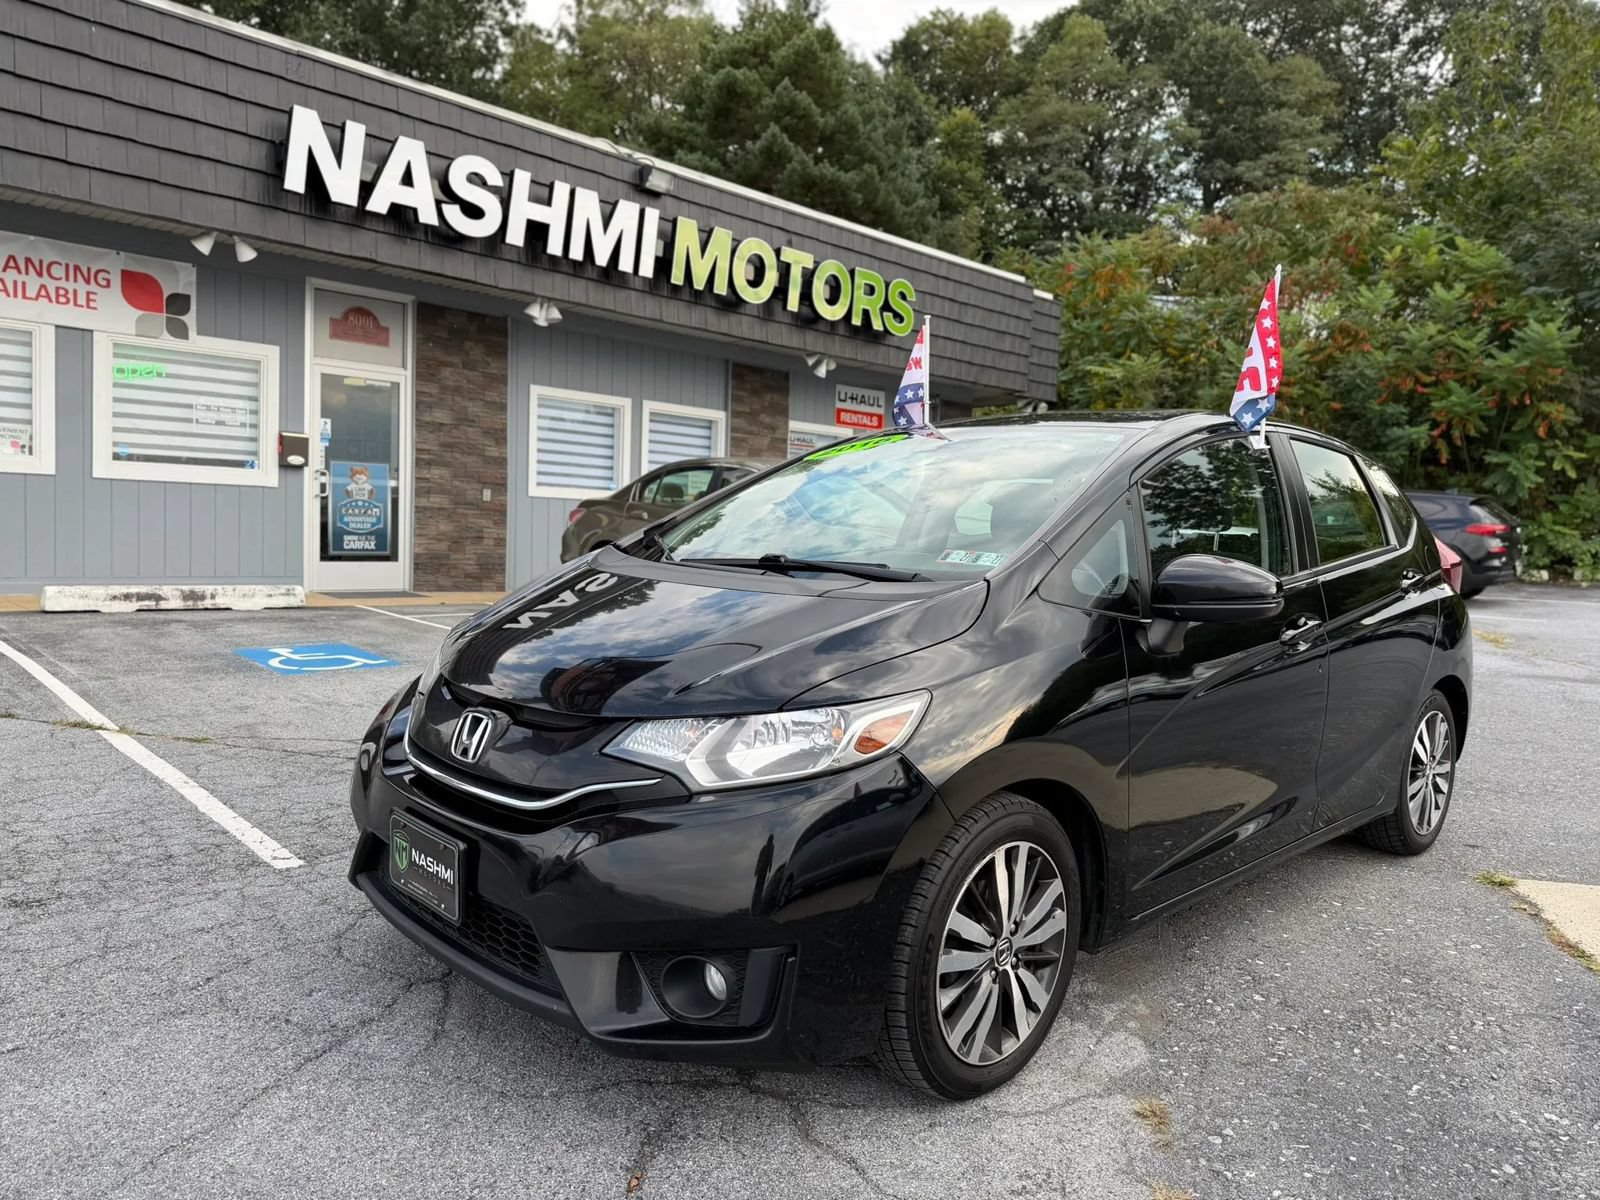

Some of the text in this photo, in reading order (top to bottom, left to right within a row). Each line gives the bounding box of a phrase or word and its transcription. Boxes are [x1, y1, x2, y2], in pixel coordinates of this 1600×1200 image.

[283, 103, 917, 337] NASHMI MOTORS
[2, 254, 112, 289] ANCING
[837, 390, 883, 408] U-HAUL
[840, 411, 879, 427] RENTALS
[343, 541, 377, 550] CARFAX
[411, 847, 454, 885] NASHMI
